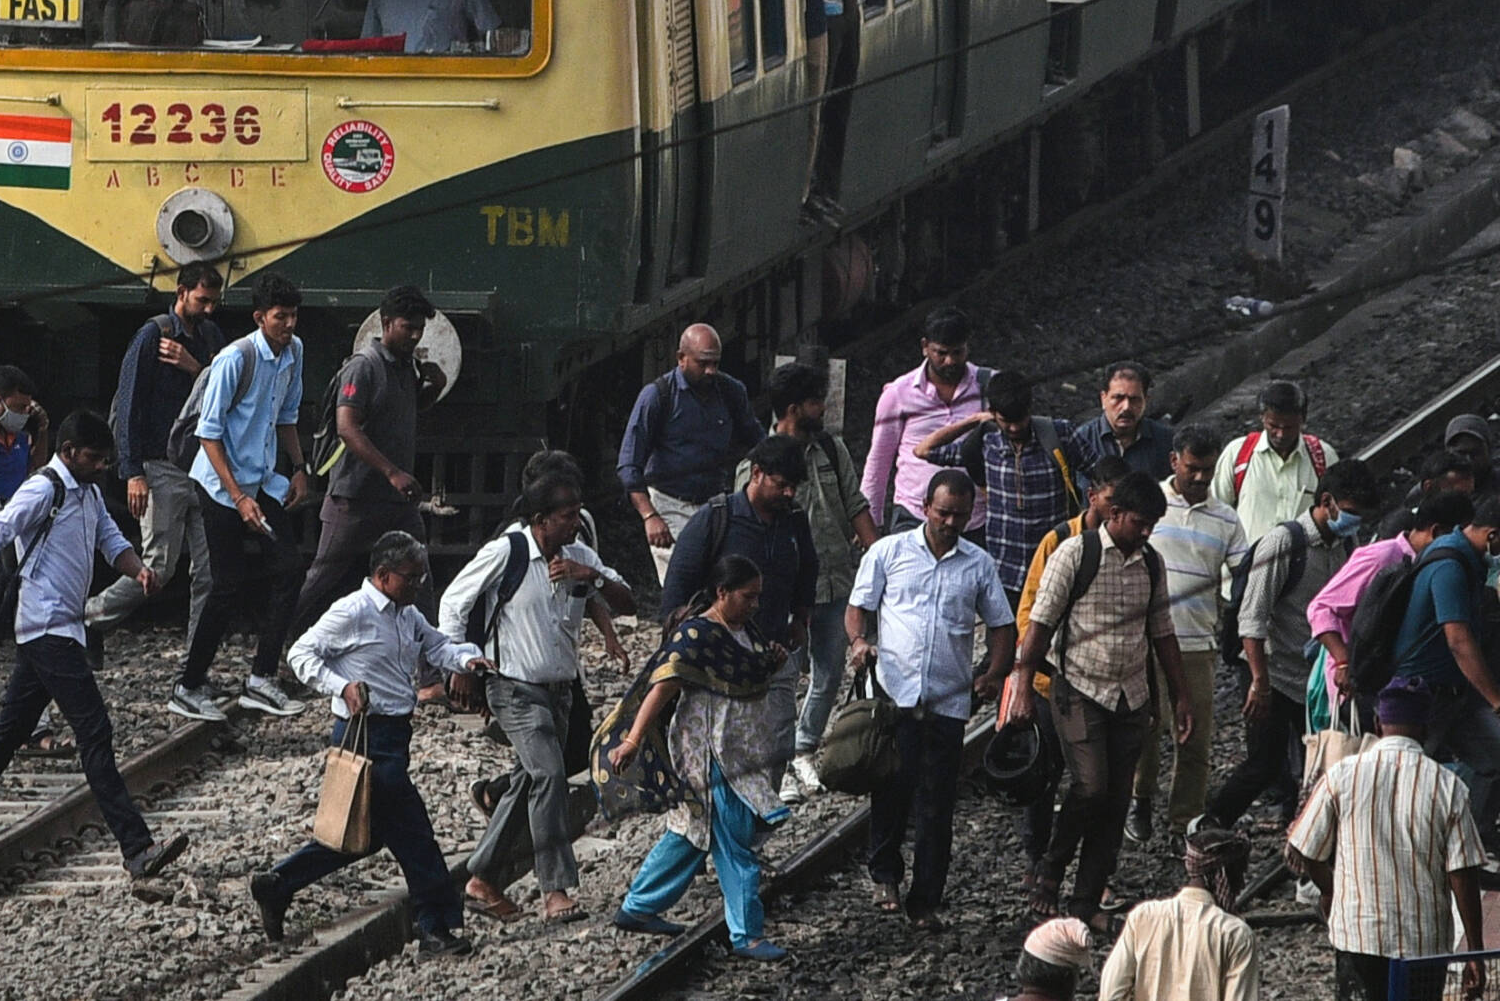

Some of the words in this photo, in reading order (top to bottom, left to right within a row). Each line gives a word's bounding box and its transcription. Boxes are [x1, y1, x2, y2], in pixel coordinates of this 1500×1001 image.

[101, 102, 261, 146] 12236
[327, 122, 390, 147] RELIABILITY
[323, 152, 353, 190] QUALITY
[364, 153, 393, 190] SAFETY
[480, 205, 570, 247] TBM
